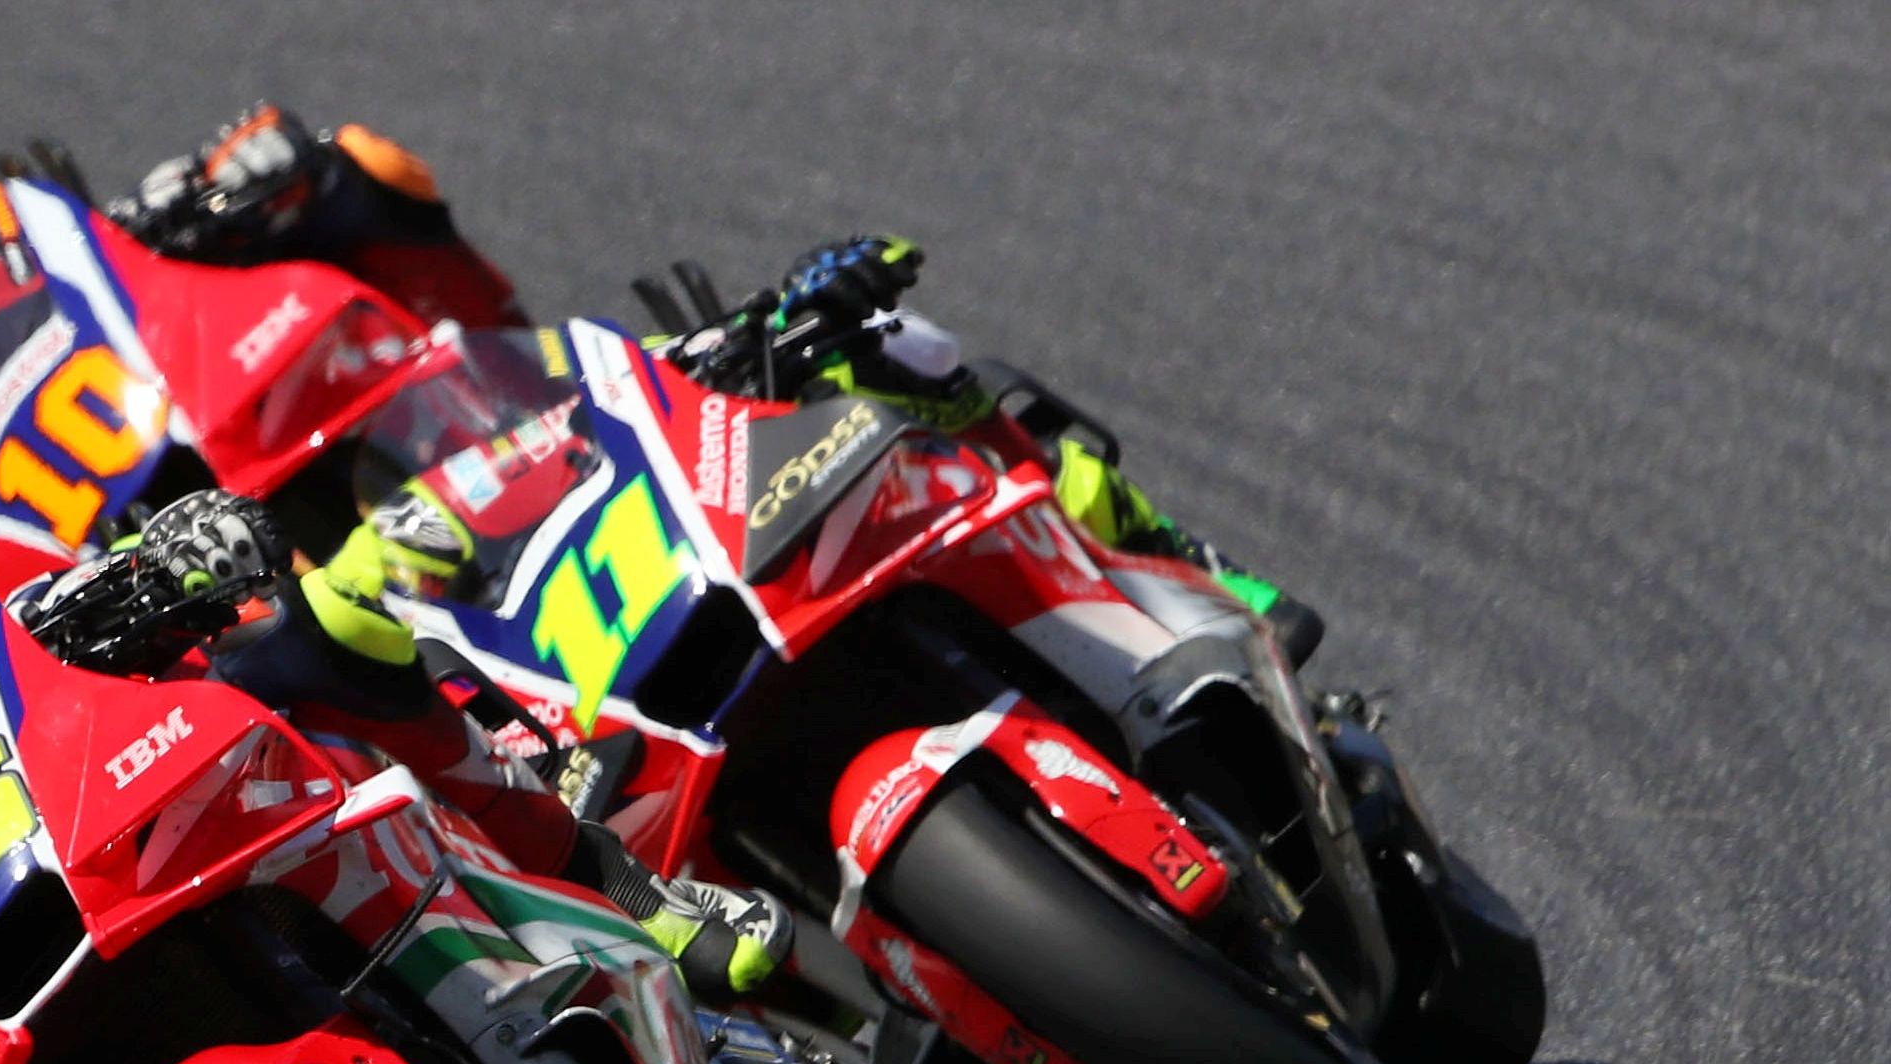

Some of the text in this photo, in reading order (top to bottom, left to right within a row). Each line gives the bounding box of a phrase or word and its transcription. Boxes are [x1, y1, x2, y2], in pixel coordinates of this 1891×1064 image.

[727, 406, 750, 516] HONDA
[532, 471, 698, 738] 11
[105, 706, 194, 790] IBM
